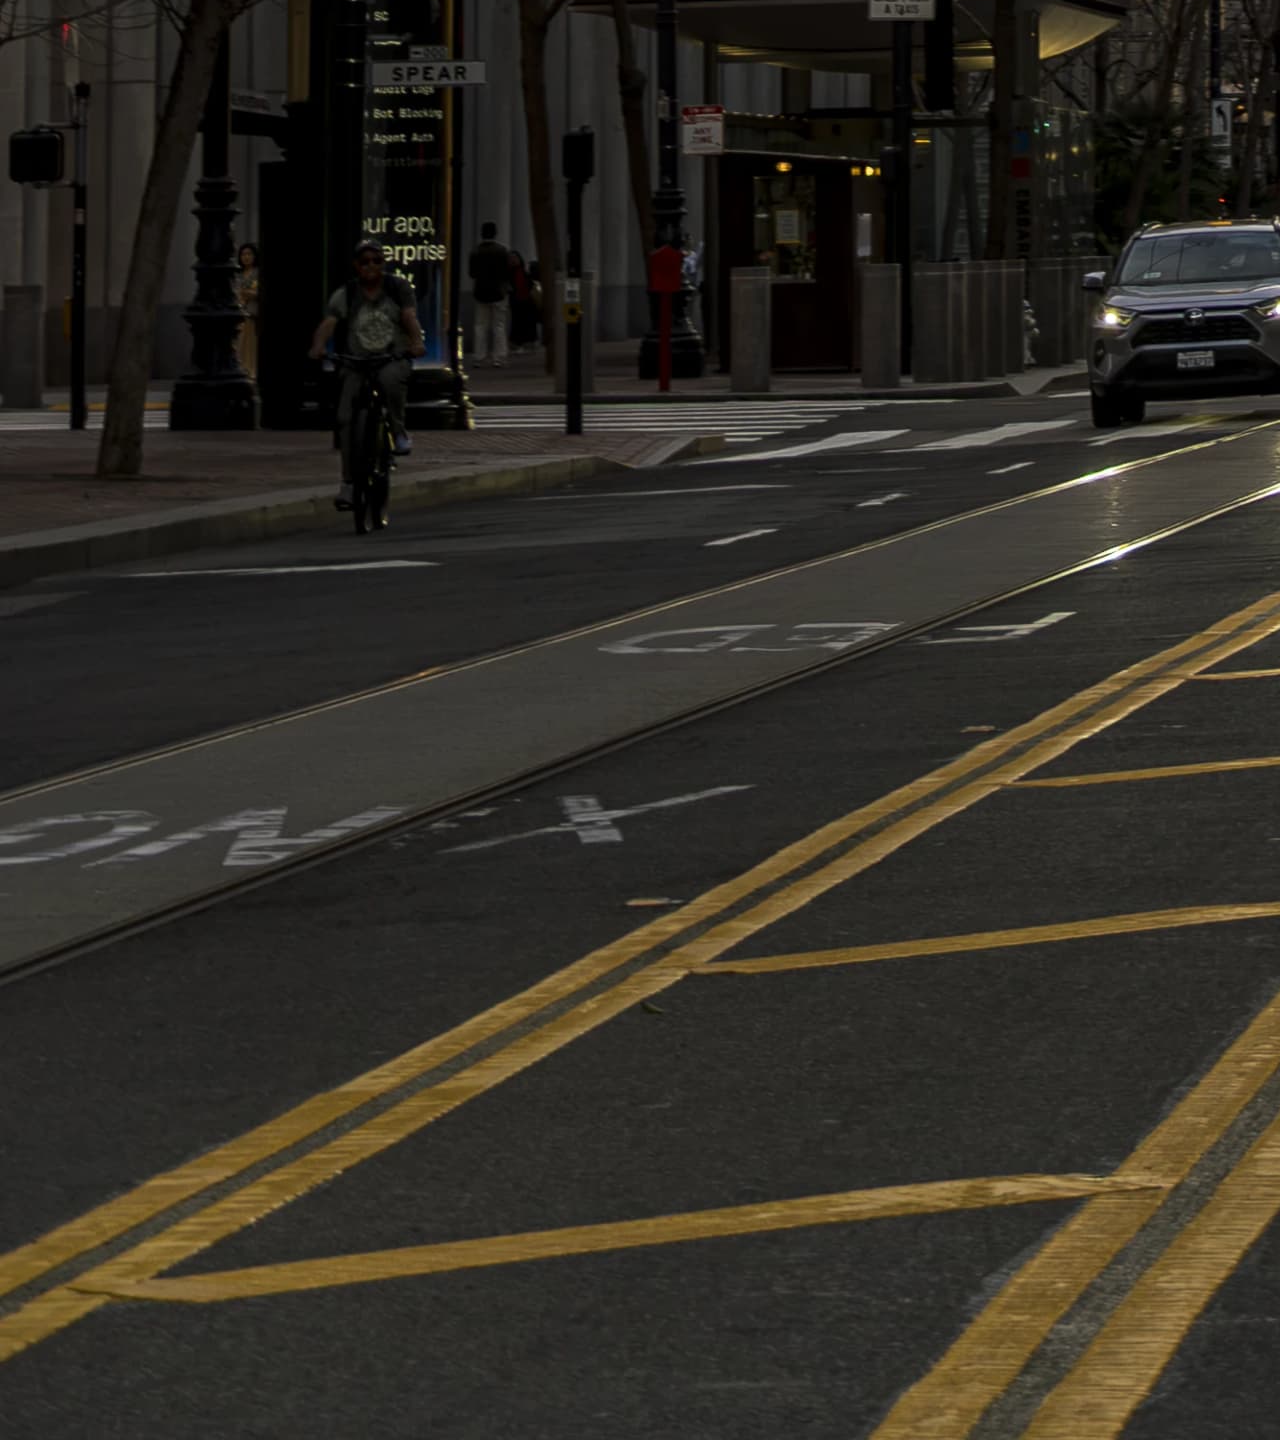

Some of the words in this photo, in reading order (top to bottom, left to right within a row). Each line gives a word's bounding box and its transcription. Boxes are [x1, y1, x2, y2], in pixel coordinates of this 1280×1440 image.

[391, 66, 467, 81] SPEAR
[373, 108, 394, 119] Bot
[399, 108, 444, 120] Blocking
[373, 132, 407, 145] Agent
[394, 215, 436, 238] app,
[382, 239, 448, 266] erprise
